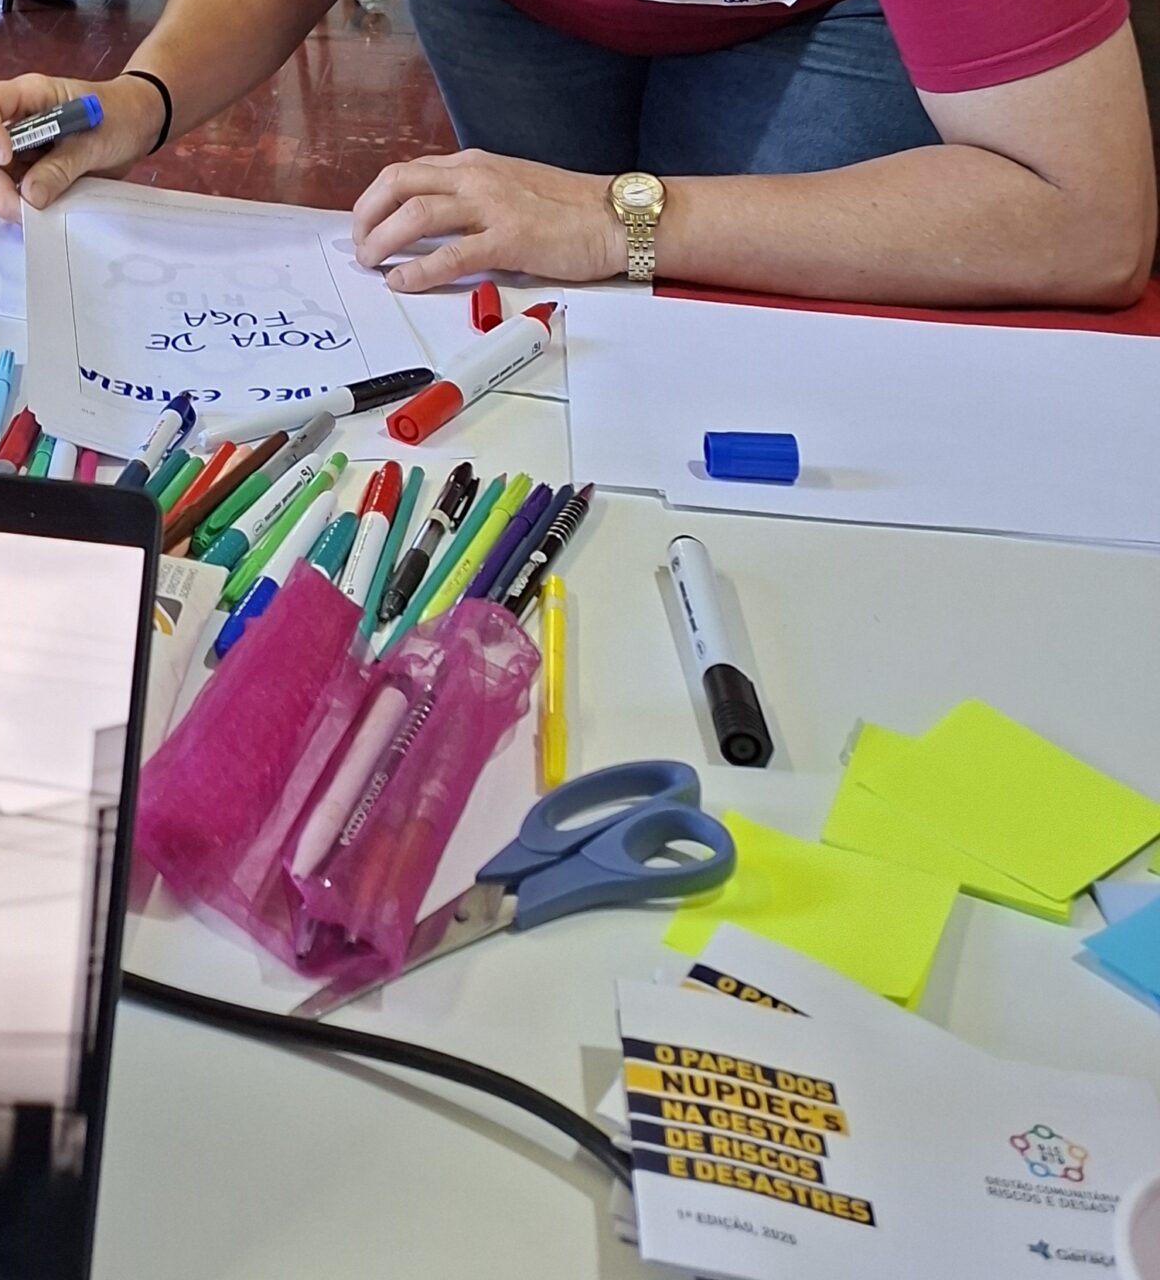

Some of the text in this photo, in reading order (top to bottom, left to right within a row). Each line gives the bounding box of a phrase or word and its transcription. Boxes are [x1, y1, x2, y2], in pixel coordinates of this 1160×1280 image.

[184, 310, 295, 328] FUGA
[146, 328, 352, 353] ROTA DE
[717, 976, 738, 995] O
[655, 1045, 834, 1103] O PAPEL DOS
[661, 1099, 705, 1126] NA
[665, 1127, 819, 1182] DE RISCOS
[668, 1155, 872, 1224] E DESASTRES
